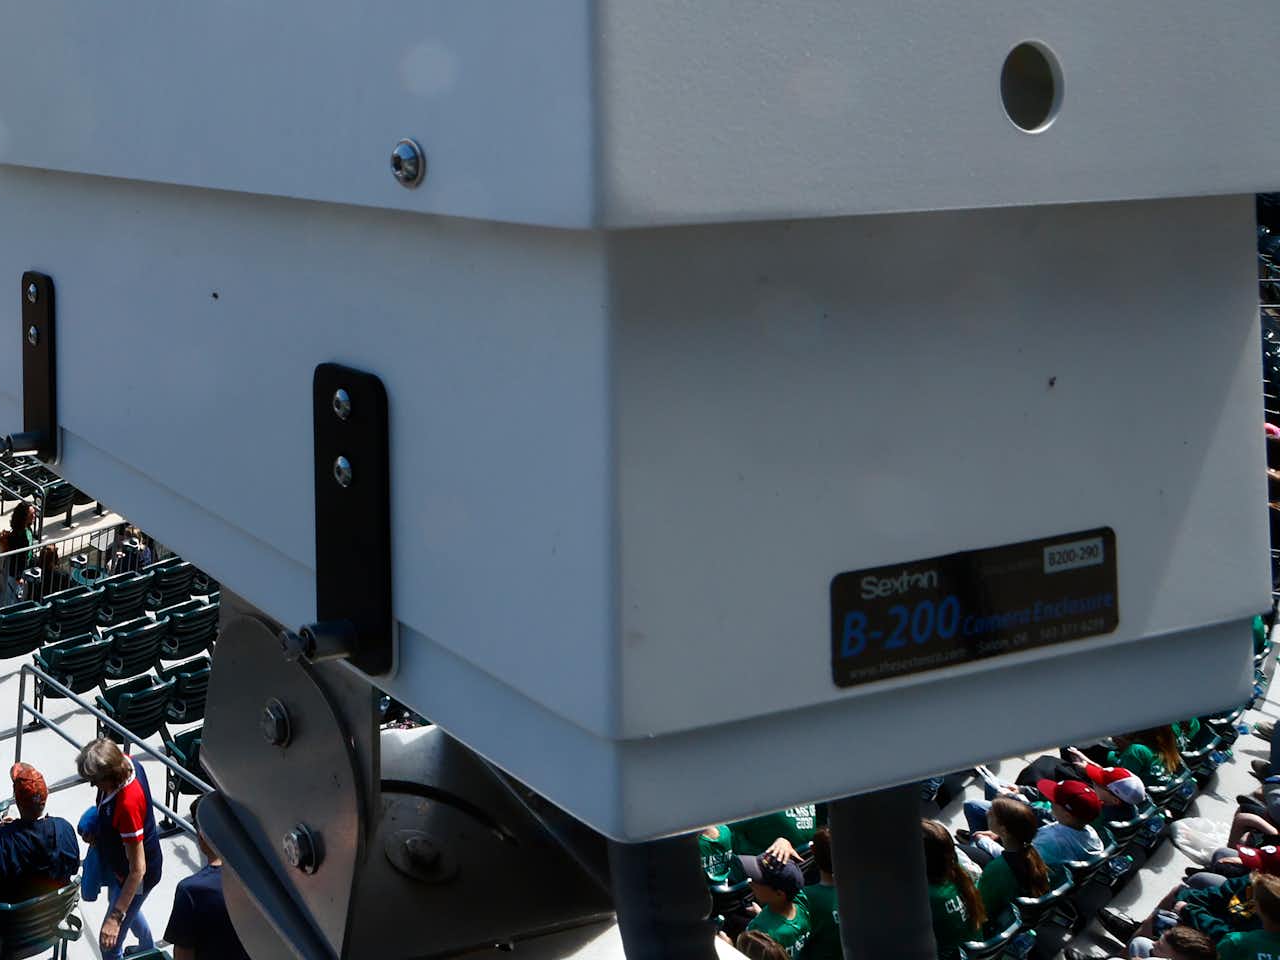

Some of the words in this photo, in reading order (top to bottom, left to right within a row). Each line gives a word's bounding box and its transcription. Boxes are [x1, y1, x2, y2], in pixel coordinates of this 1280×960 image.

[1048, 544, 1099, 568] B200-290
[860, 569, 938, 600] Sexton
[841, 595, 960, 658] B-200
